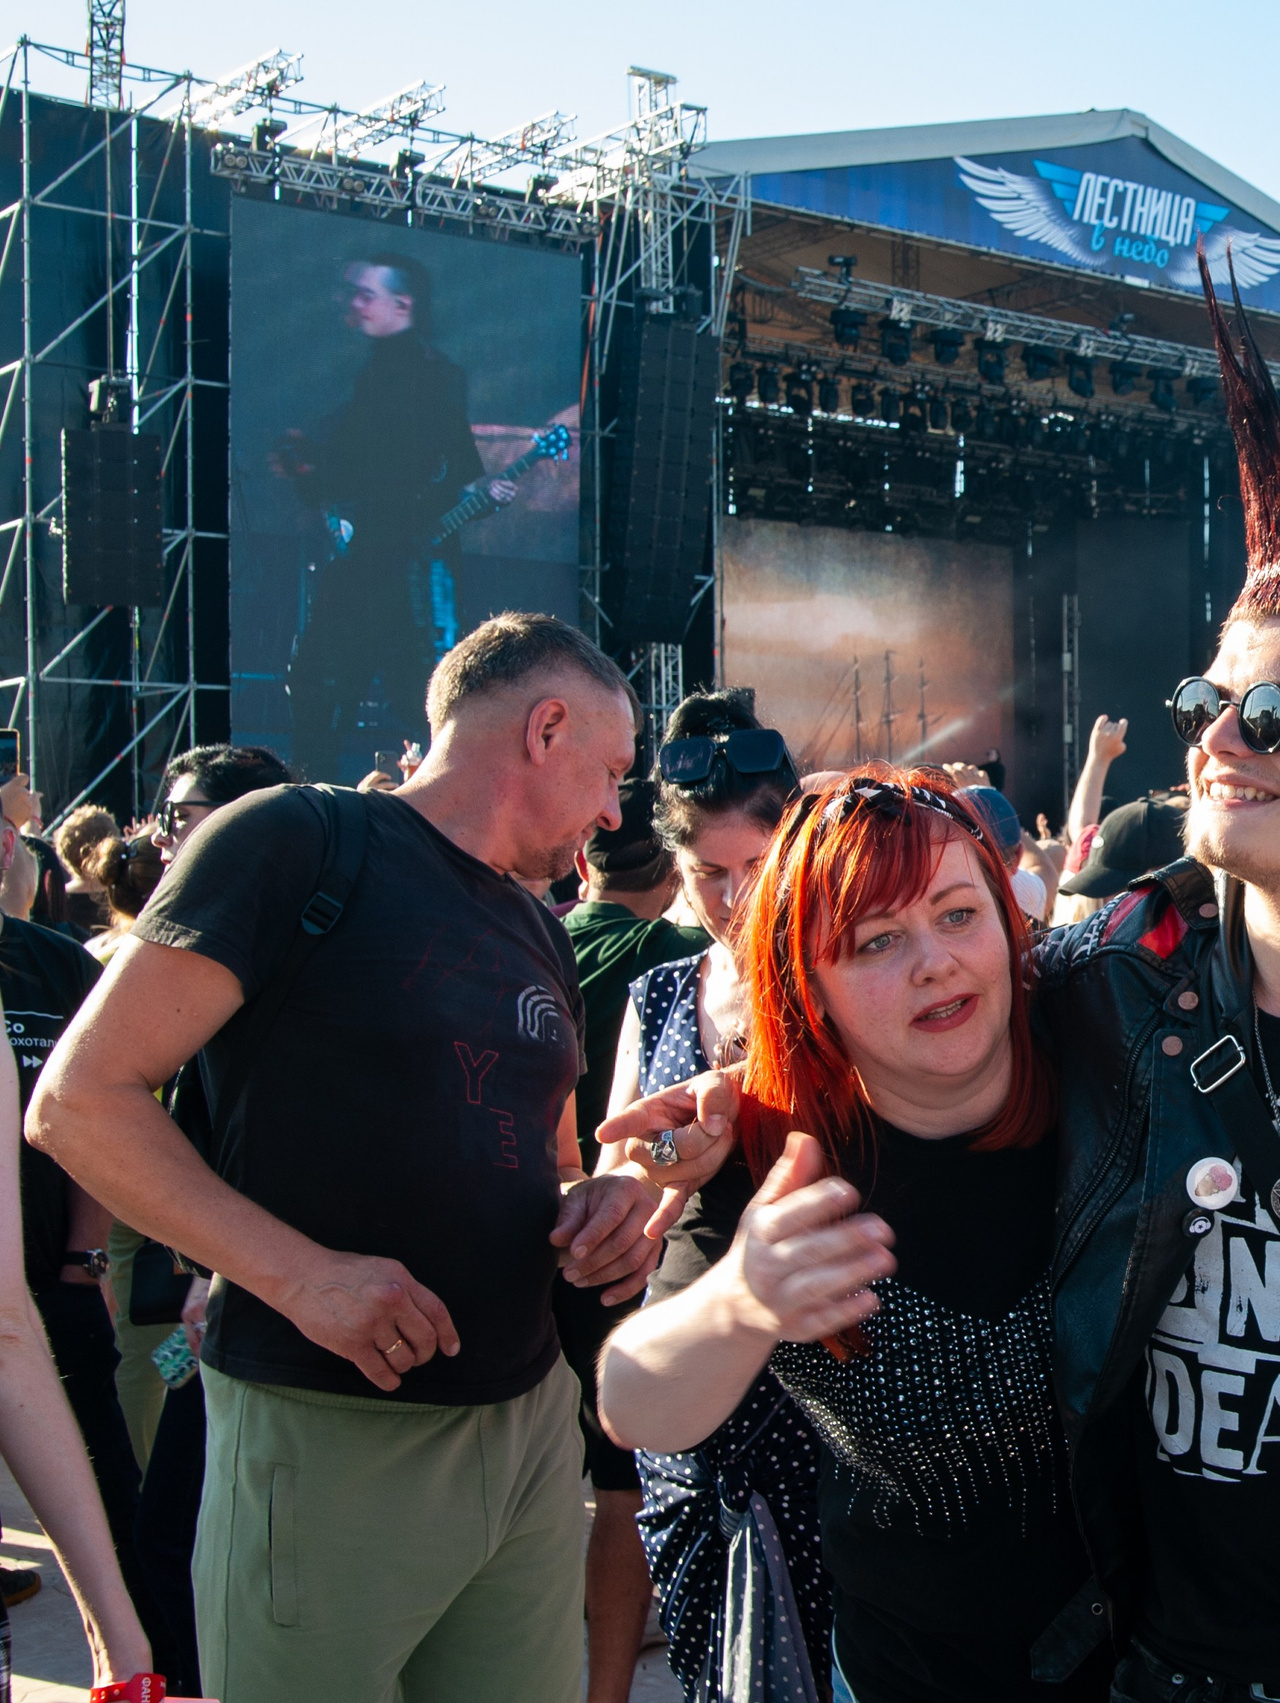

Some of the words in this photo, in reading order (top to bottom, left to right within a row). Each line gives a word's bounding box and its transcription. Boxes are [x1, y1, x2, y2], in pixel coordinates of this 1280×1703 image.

[1072, 172, 1196, 247] ЛЕСТНИЦА
[1113, 234, 1169, 269] небо
[10, 1037, 60, 1048] охотал
